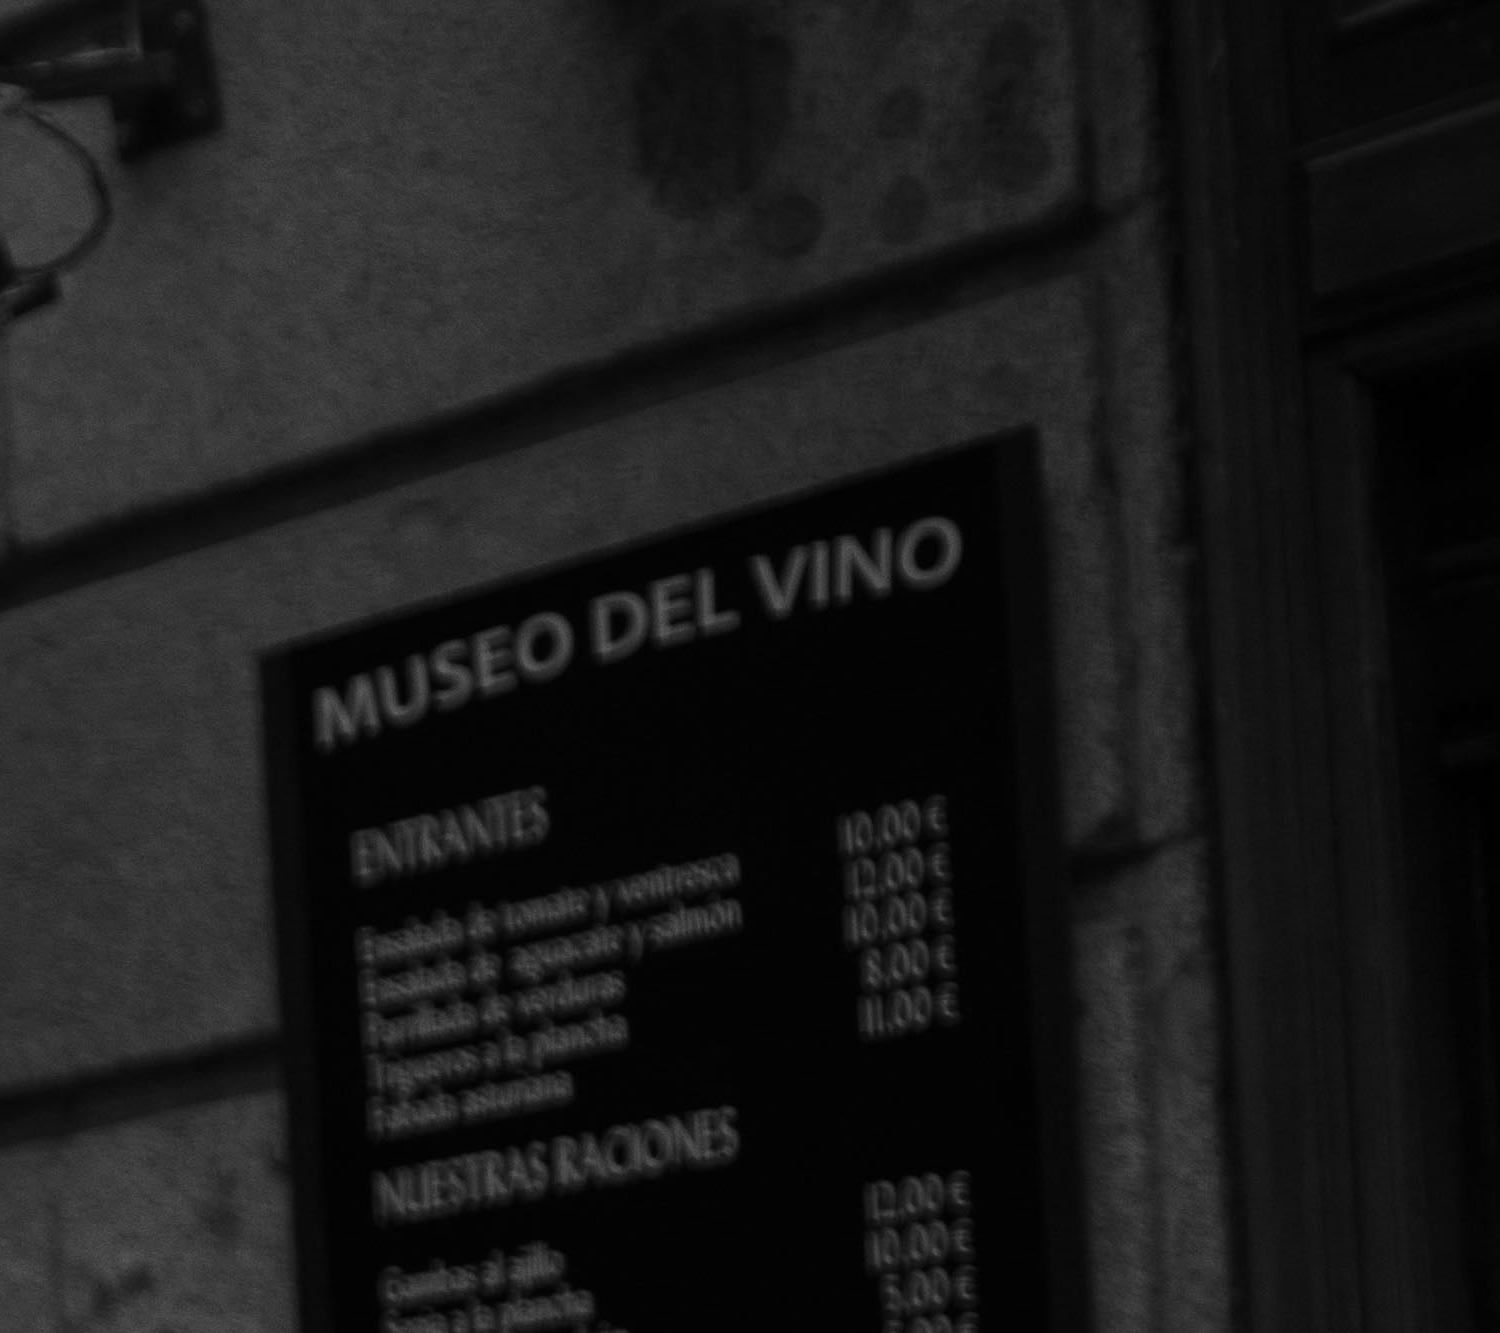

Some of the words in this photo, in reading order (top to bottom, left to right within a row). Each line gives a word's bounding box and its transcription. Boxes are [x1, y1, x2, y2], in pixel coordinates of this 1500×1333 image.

[311, 608, 575, 756] MUSEO
[586, 565, 742, 666] DEL
[746, 515, 964, 622] VINO
[349, 784, 550, 888] ENTRANTES
[371, 1141, 549, 1228] NUESTRAS
[551, 1104, 740, 1196] RACIONES
